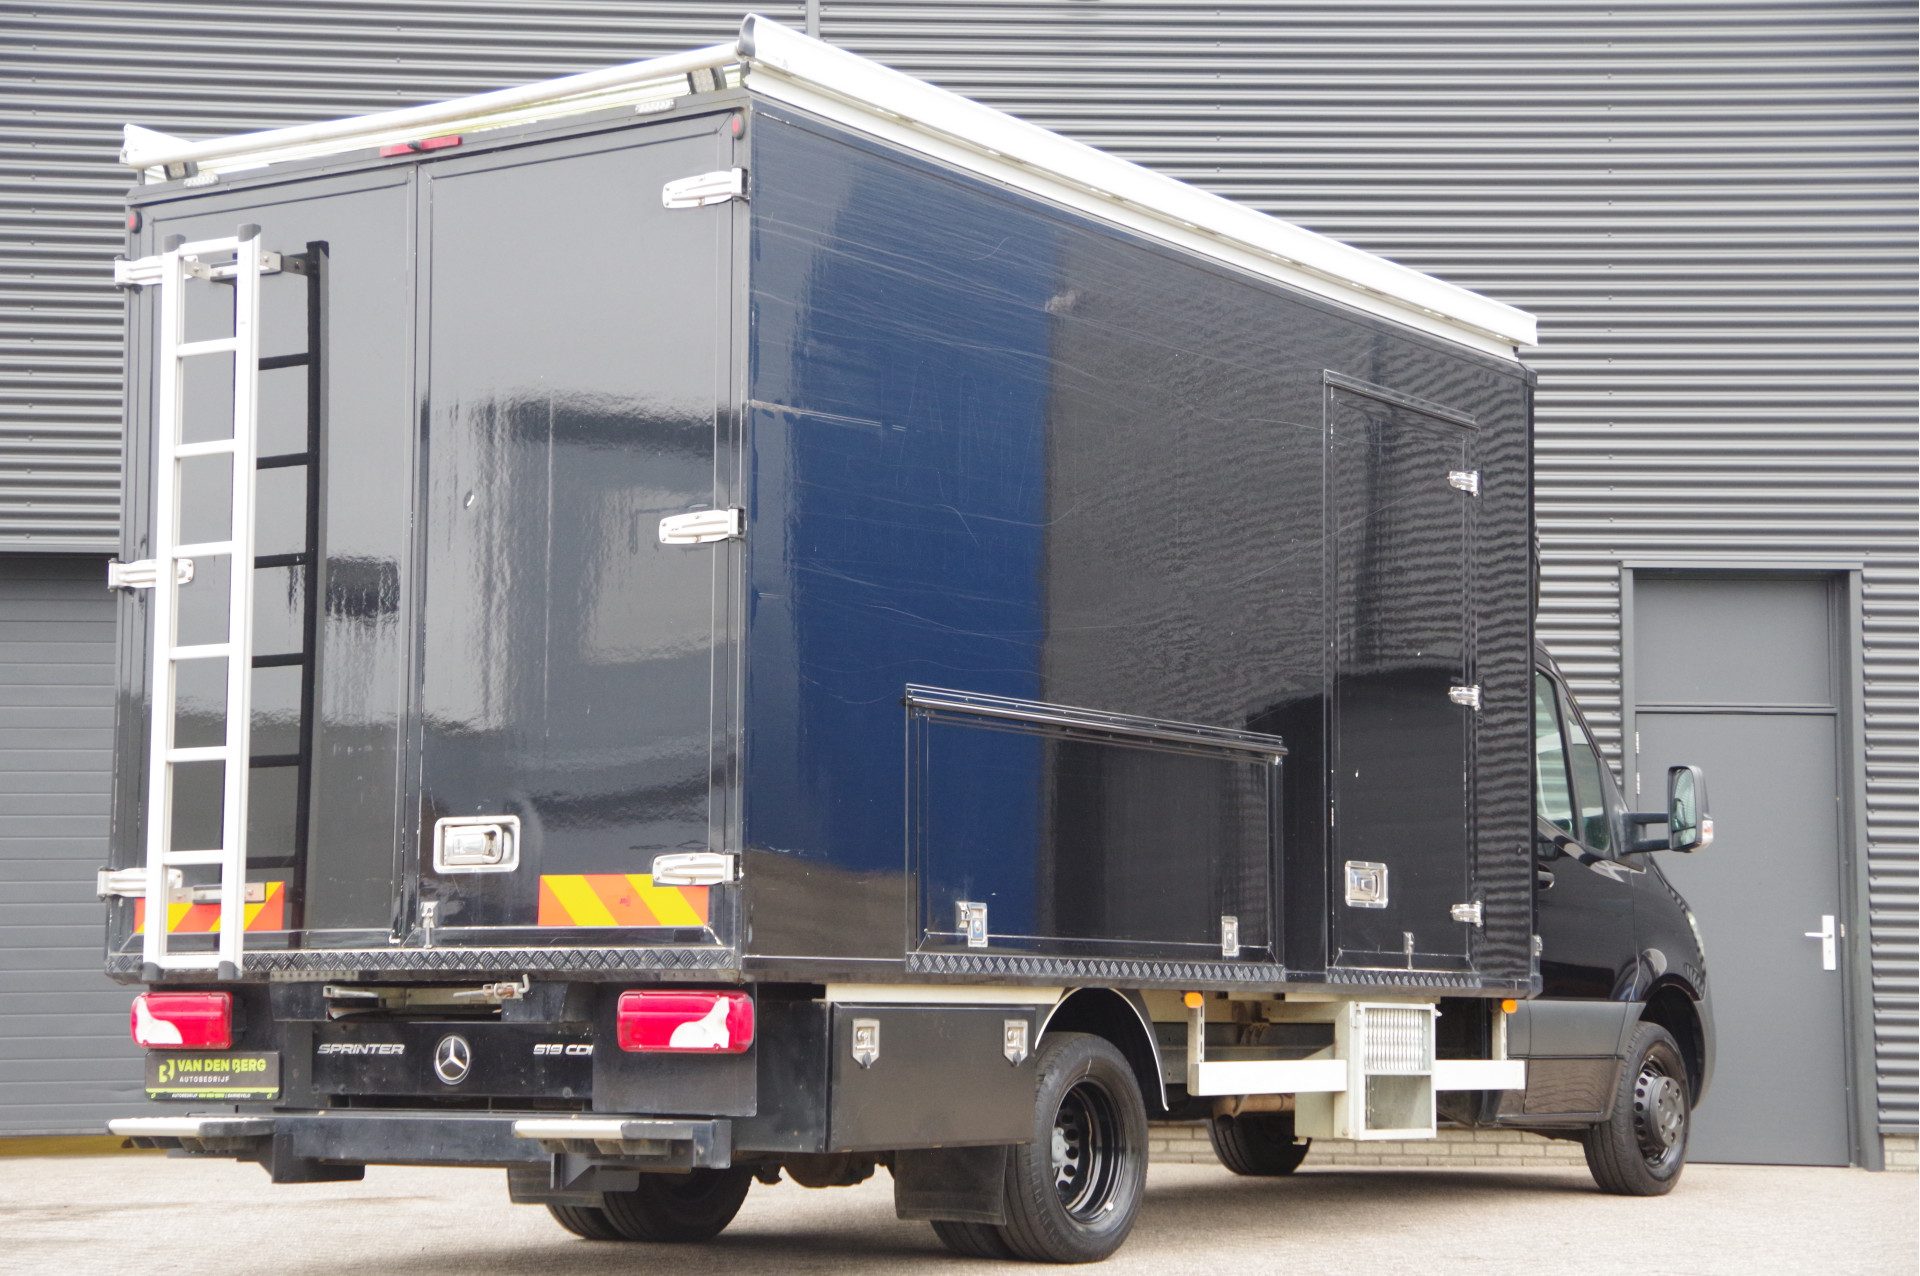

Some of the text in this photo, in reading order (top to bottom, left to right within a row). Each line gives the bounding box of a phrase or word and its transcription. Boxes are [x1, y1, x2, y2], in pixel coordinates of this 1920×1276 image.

[317, 1043, 405, 1055] SPRINTER
[533, 1043, 563, 1055] 519
[178, 1058, 267, 1073] VAN DEN BERG
